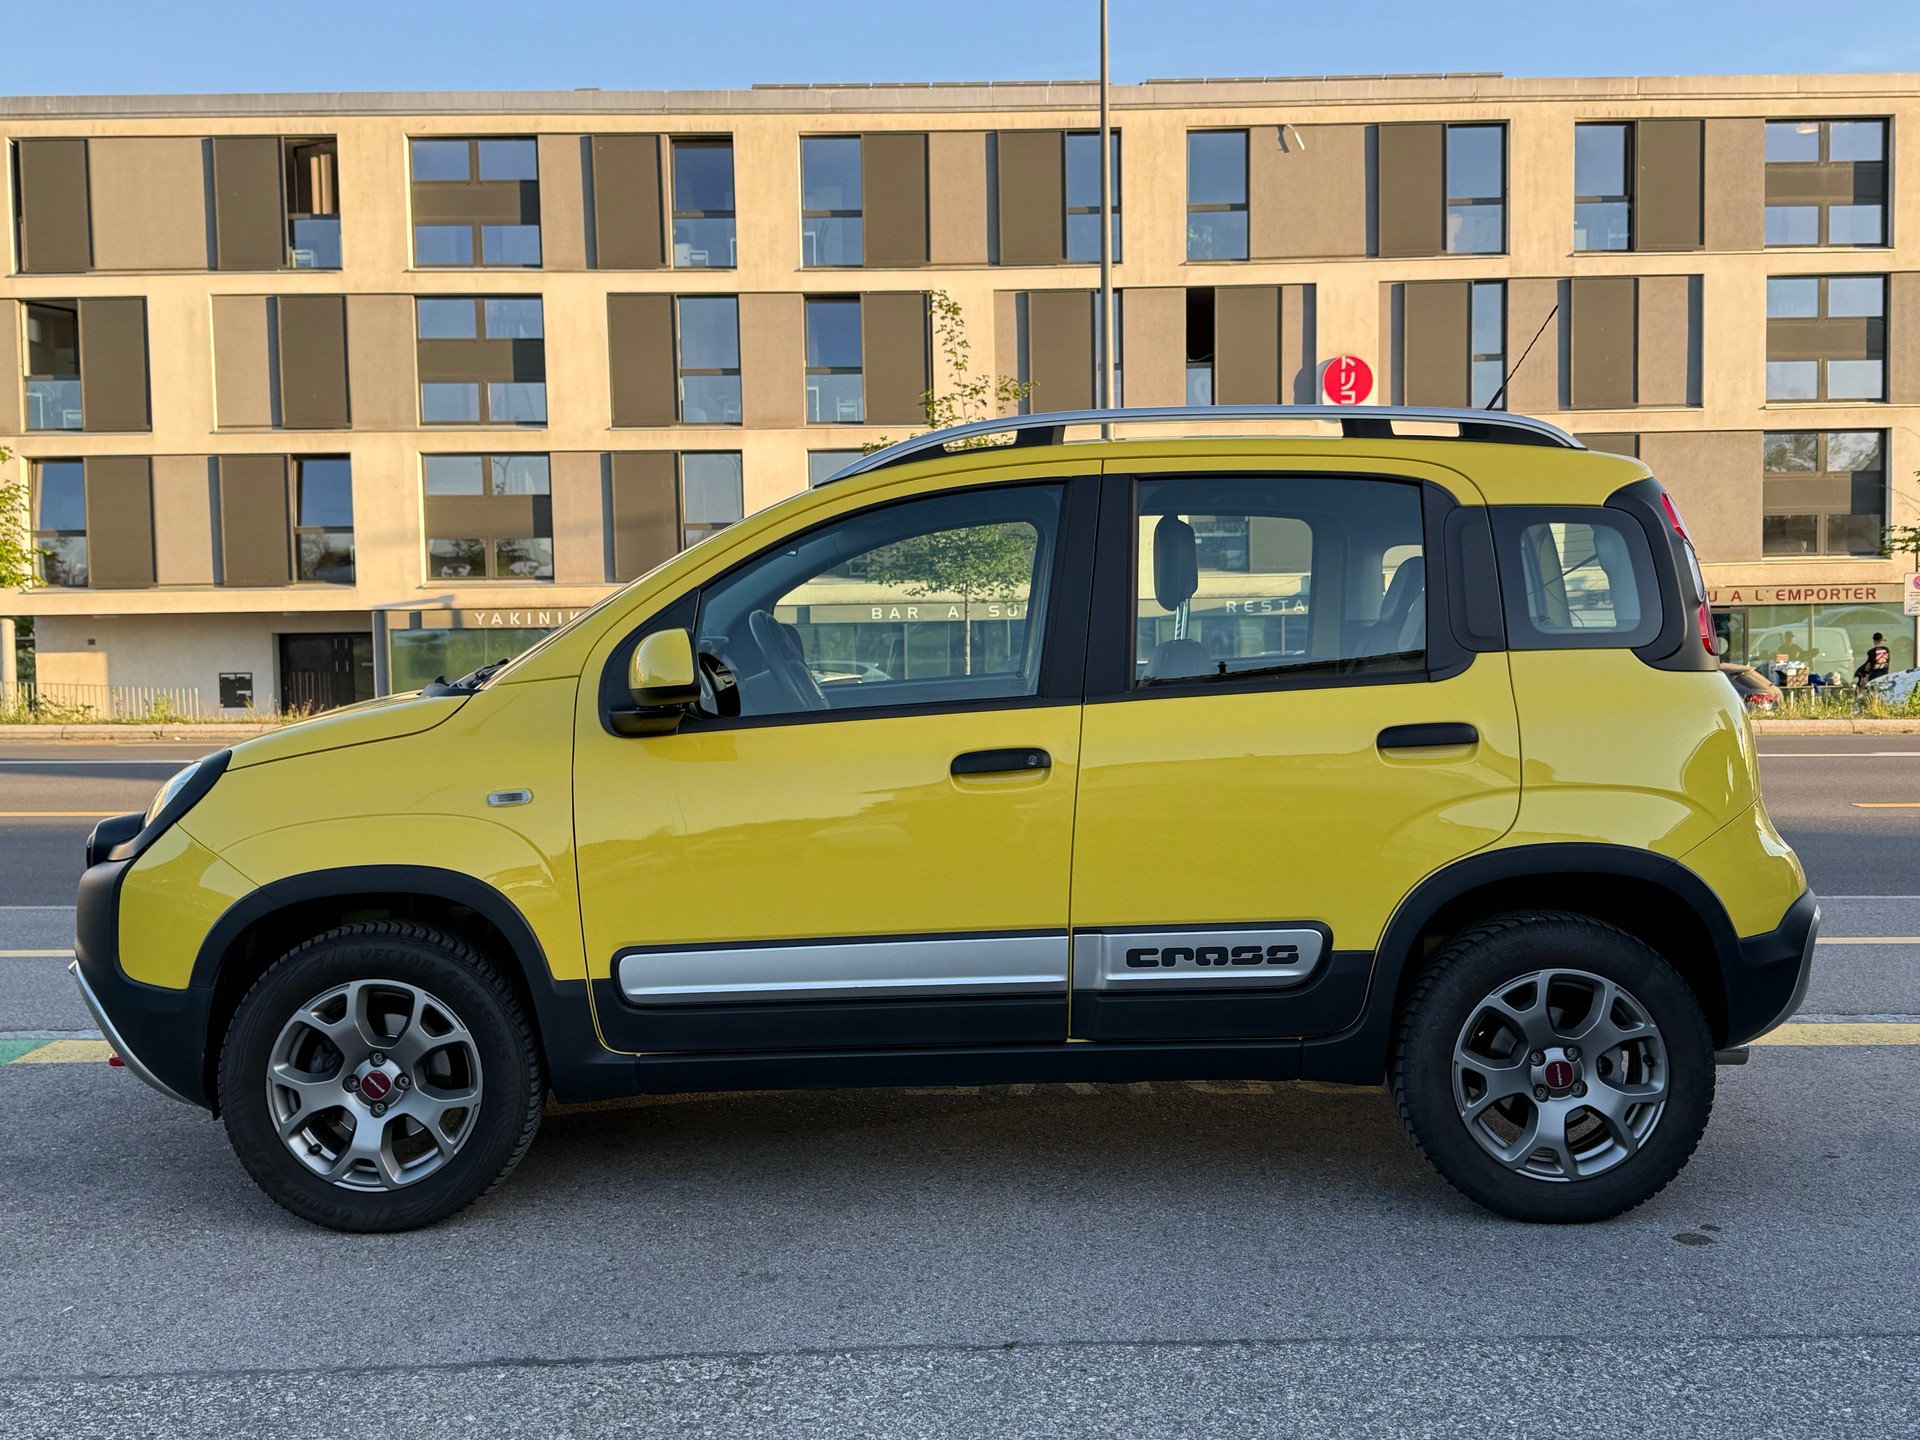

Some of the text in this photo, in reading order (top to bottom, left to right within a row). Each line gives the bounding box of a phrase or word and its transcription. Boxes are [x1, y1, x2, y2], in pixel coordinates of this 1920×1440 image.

[1731, 590, 1743, 601] A
[871, 607, 918, 620] BAR
[948, 606, 959, 618] A
